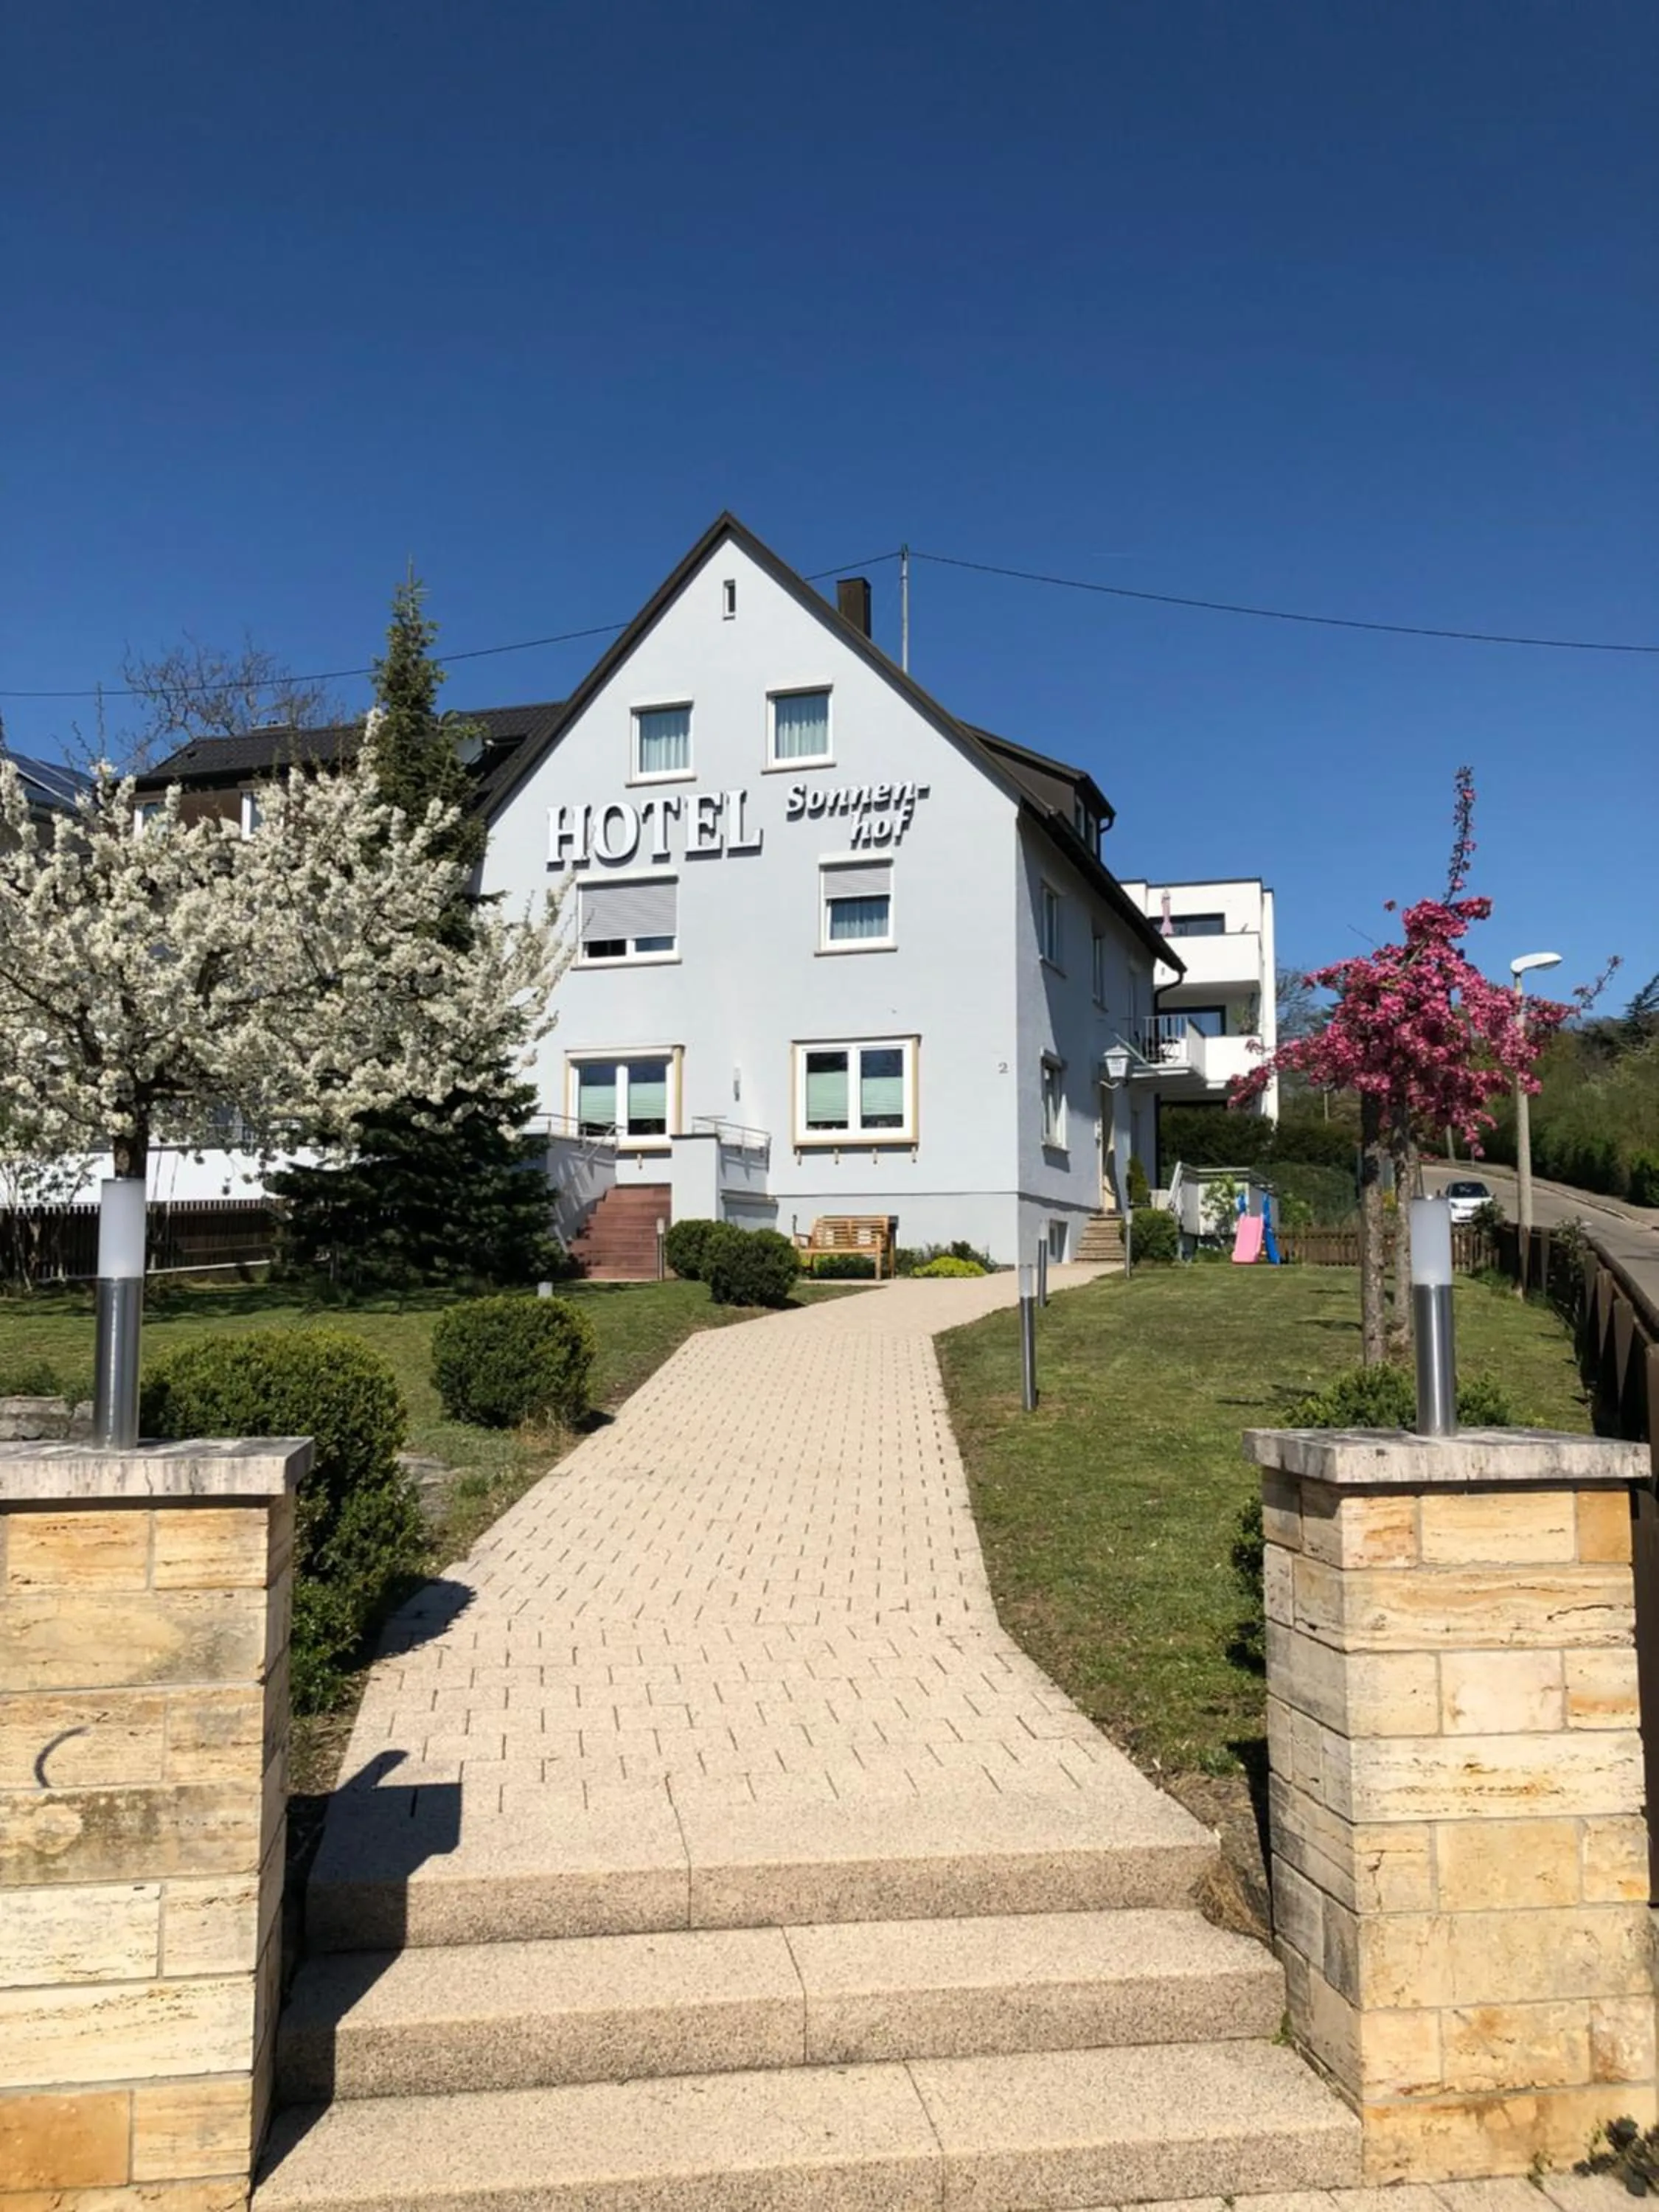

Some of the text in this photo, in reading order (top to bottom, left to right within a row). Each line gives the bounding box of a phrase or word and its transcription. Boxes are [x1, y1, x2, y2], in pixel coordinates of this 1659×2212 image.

[546, 790, 763, 866] HOTEL
[850, 804, 913, 844] hof
[998, 1062, 1009, 1074] 2
